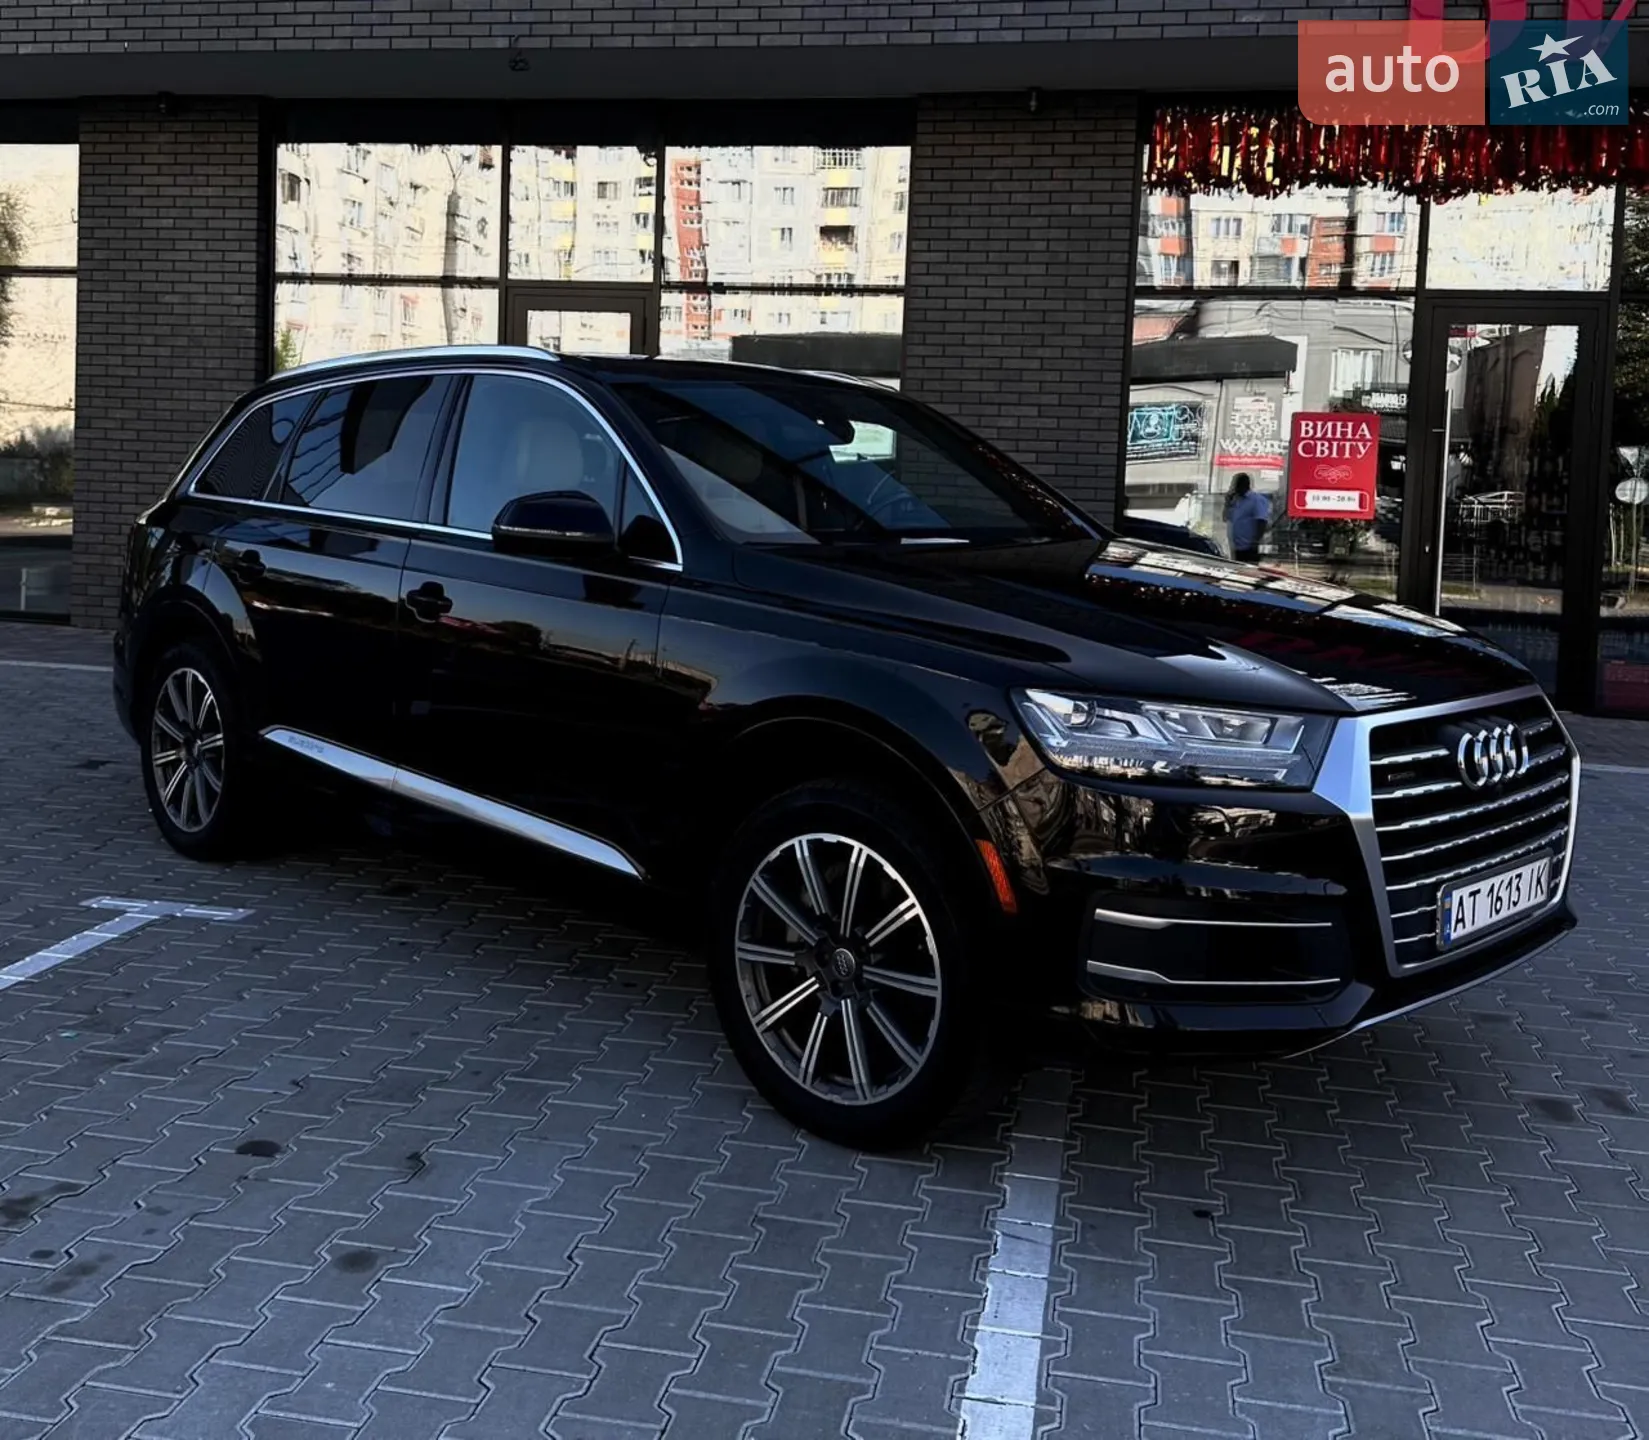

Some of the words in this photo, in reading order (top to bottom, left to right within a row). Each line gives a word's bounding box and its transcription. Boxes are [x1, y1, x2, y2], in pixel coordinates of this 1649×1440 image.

[1300, 420, 1372, 439] ВИНА
[1298, 440, 1372, 459] СВІТУ
[1453, 888, 1481, 933] AT
[1487, 872, 1523, 919] 1613
[1527, 862, 1548, 902] IK
